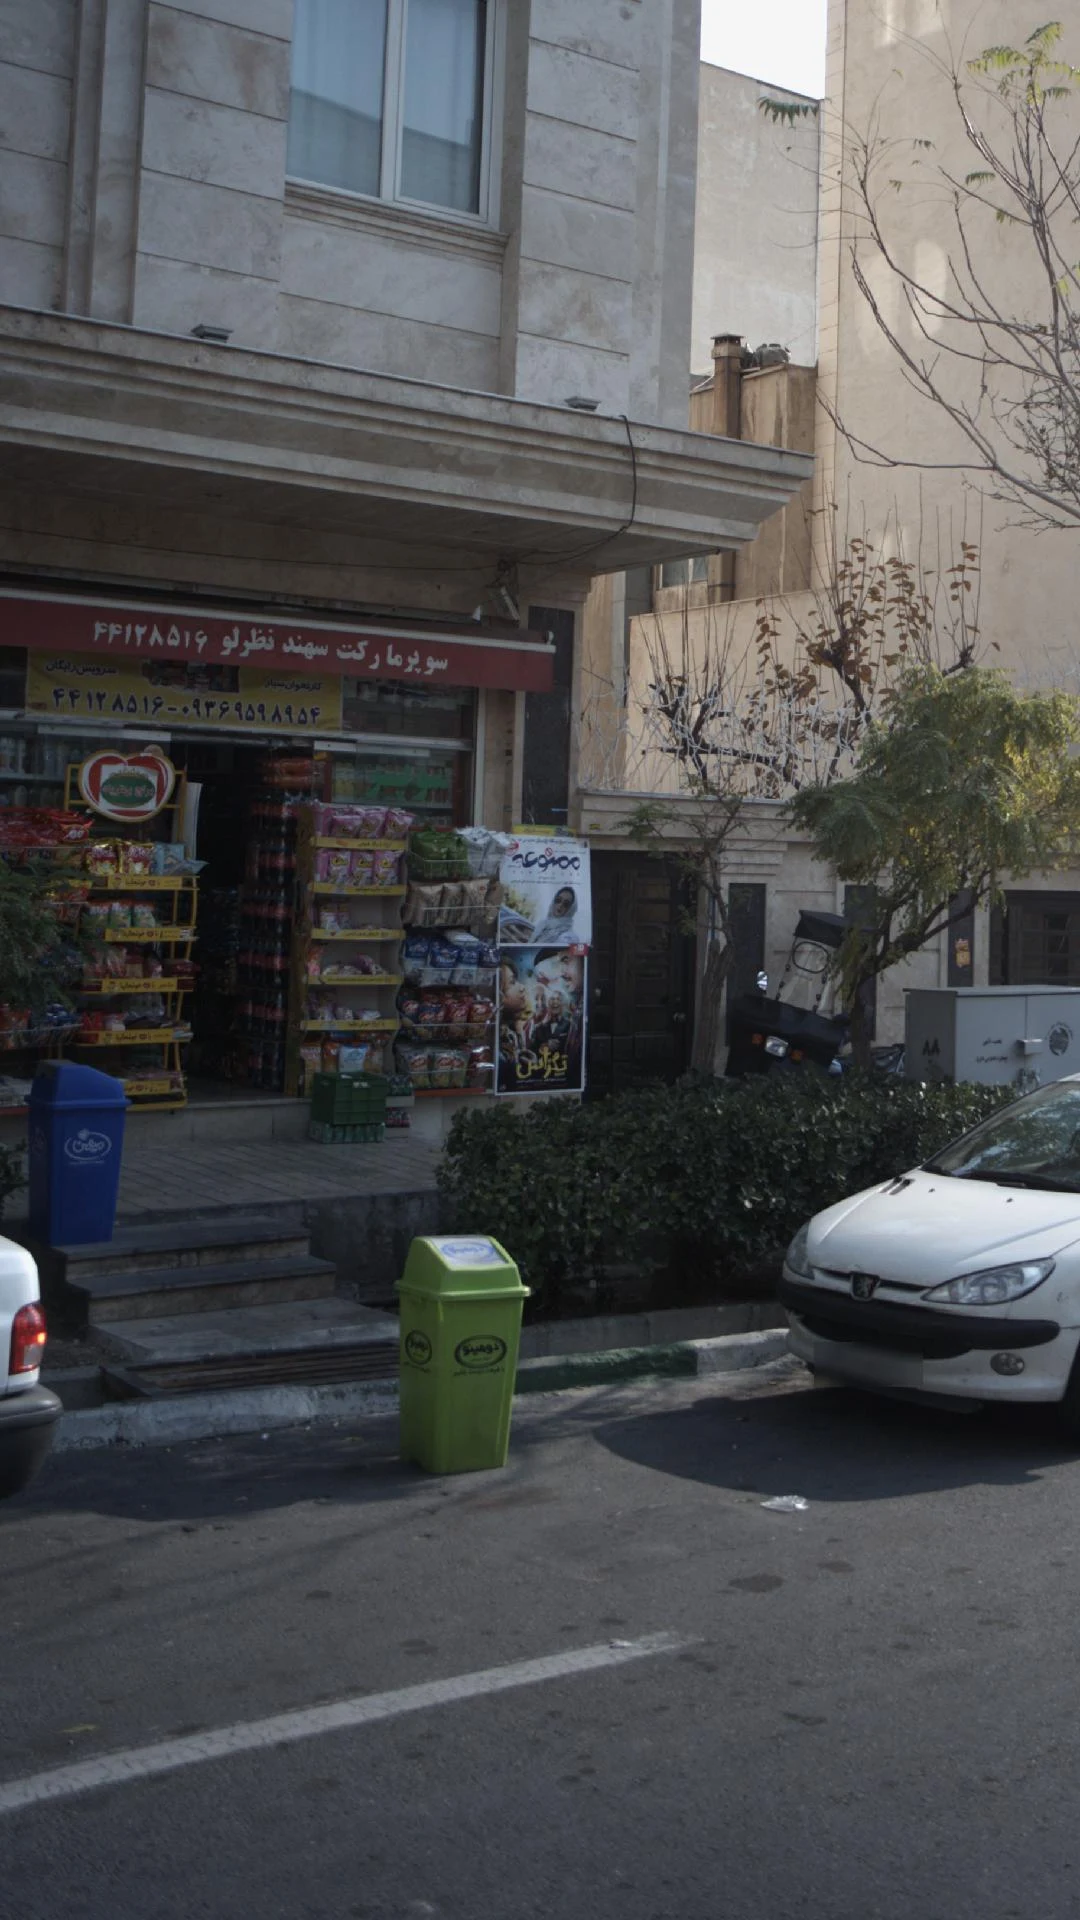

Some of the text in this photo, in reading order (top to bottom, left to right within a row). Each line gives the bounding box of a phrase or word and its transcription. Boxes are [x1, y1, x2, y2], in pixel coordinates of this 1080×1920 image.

[94, 621, 208, 655] ۴۴۱۲۸۵۱۶
[219, 627, 275, 658] نظرلو
[282, 635, 329, 660] سهند
